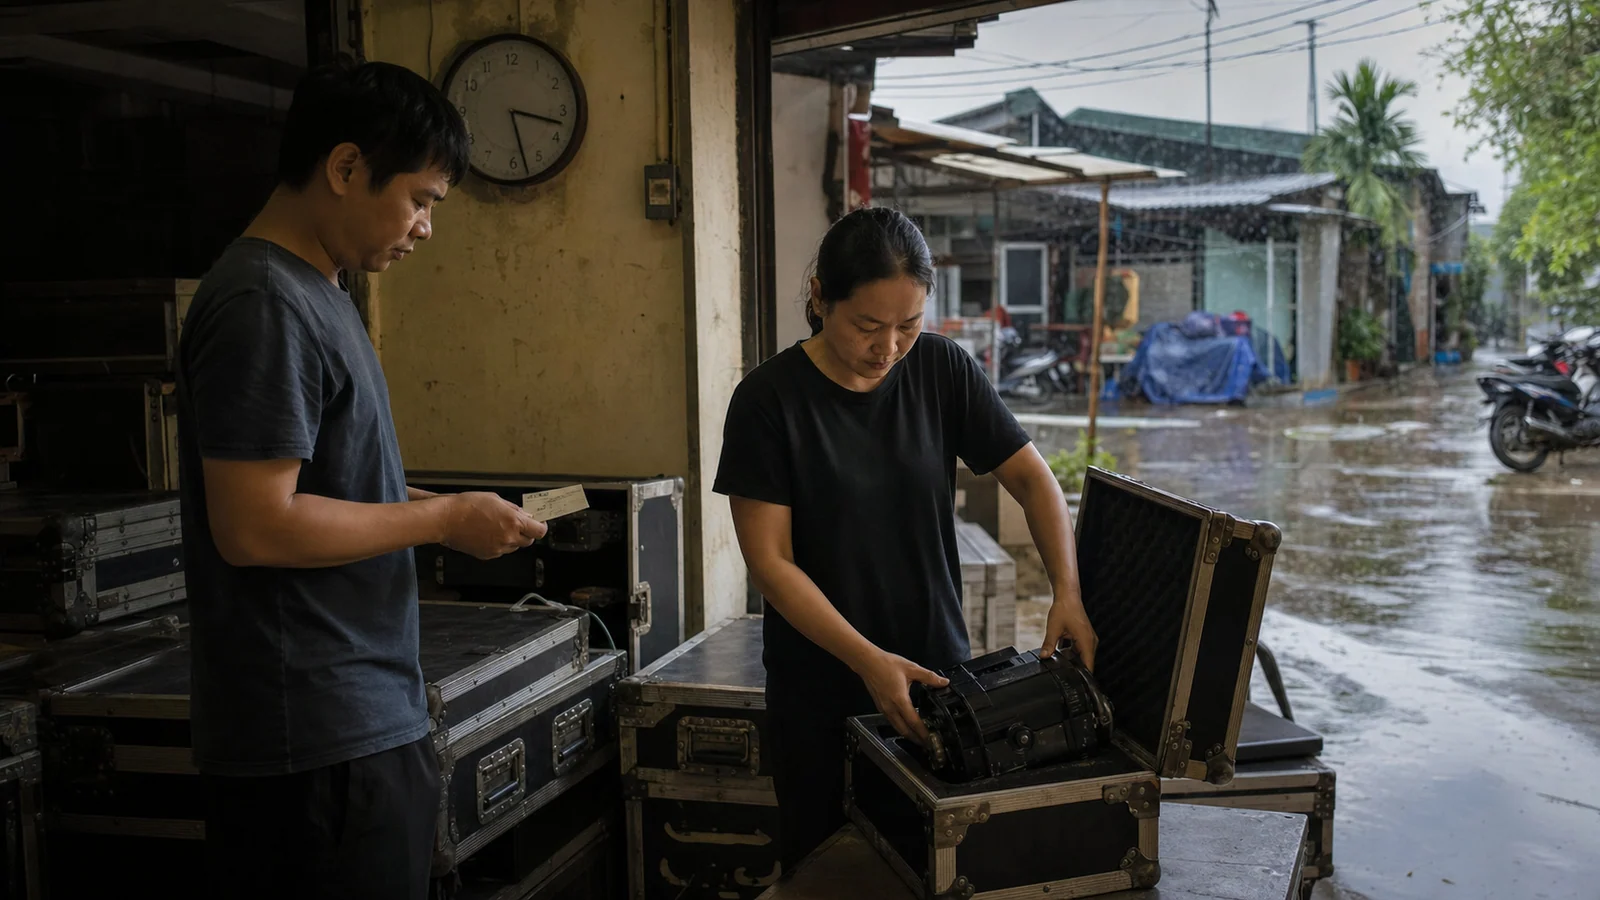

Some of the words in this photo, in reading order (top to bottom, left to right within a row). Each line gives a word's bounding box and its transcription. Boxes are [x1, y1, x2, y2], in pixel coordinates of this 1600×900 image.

[505, 53, 518, 66] 12
[535, 60, 540, 71] 1
[482, 61, 491, 73] 11
[464, 79, 478, 92] 10
[551, 77, 560, 90] 2
[459, 106, 467, 117] 9
[559, 104, 568, 117] 3
[552, 131, 561, 143] 4
[484, 150, 492, 162] 7
[535, 150, 543, 162] 5
[509, 157, 518, 169] 6
